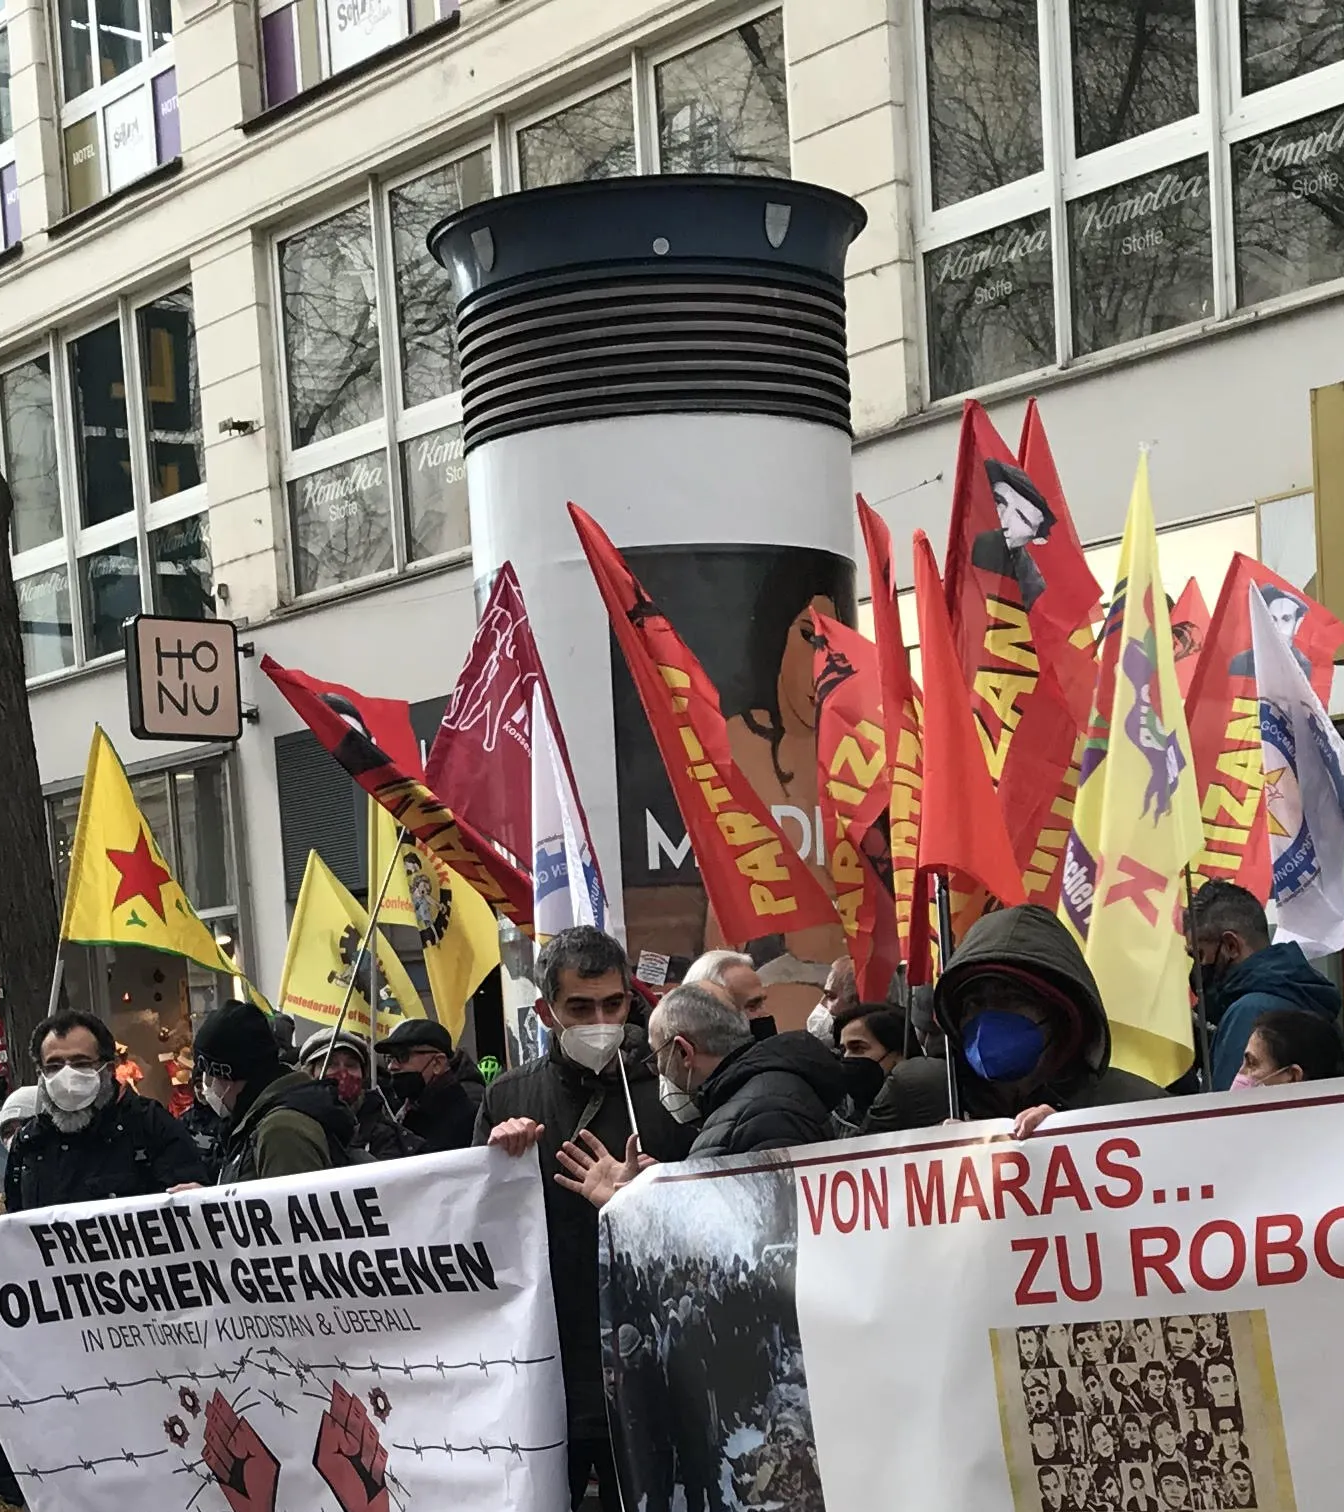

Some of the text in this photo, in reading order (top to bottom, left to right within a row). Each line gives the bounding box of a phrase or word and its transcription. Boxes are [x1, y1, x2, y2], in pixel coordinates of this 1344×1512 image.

[72, 143, 96, 166] HOTEL
[1080, 171, 1205, 236] Komolka
[1291, 169, 1340, 201] Stoffe
[937, 226, 1048, 285] Komolka
[1121, 226, 1164, 257] Stoffe
[974, 279, 1013, 306] Stoffe
[303, 463, 383, 510] Komolka
[156, 636, 218, 679] HO
[157, 683, 220, 718] NU
[801, 1137, 1215, 1236] VON MARAS...
[31, 1186, 390, 1268] FREIHEIT FÜR ALLE
[230, 1241, 499, 1305] GEFANGENEN
[1010, 1232, 1101, 1306] ZU
[80, 1328, 103, 1353] IN
[106, 1325, 146, 1351] DER
[216, 1314, 314, 1341] KURDISTAN
[317, 1313, 335, 1337] &
[338, 1305, 421, 1336] ÜBERALL
